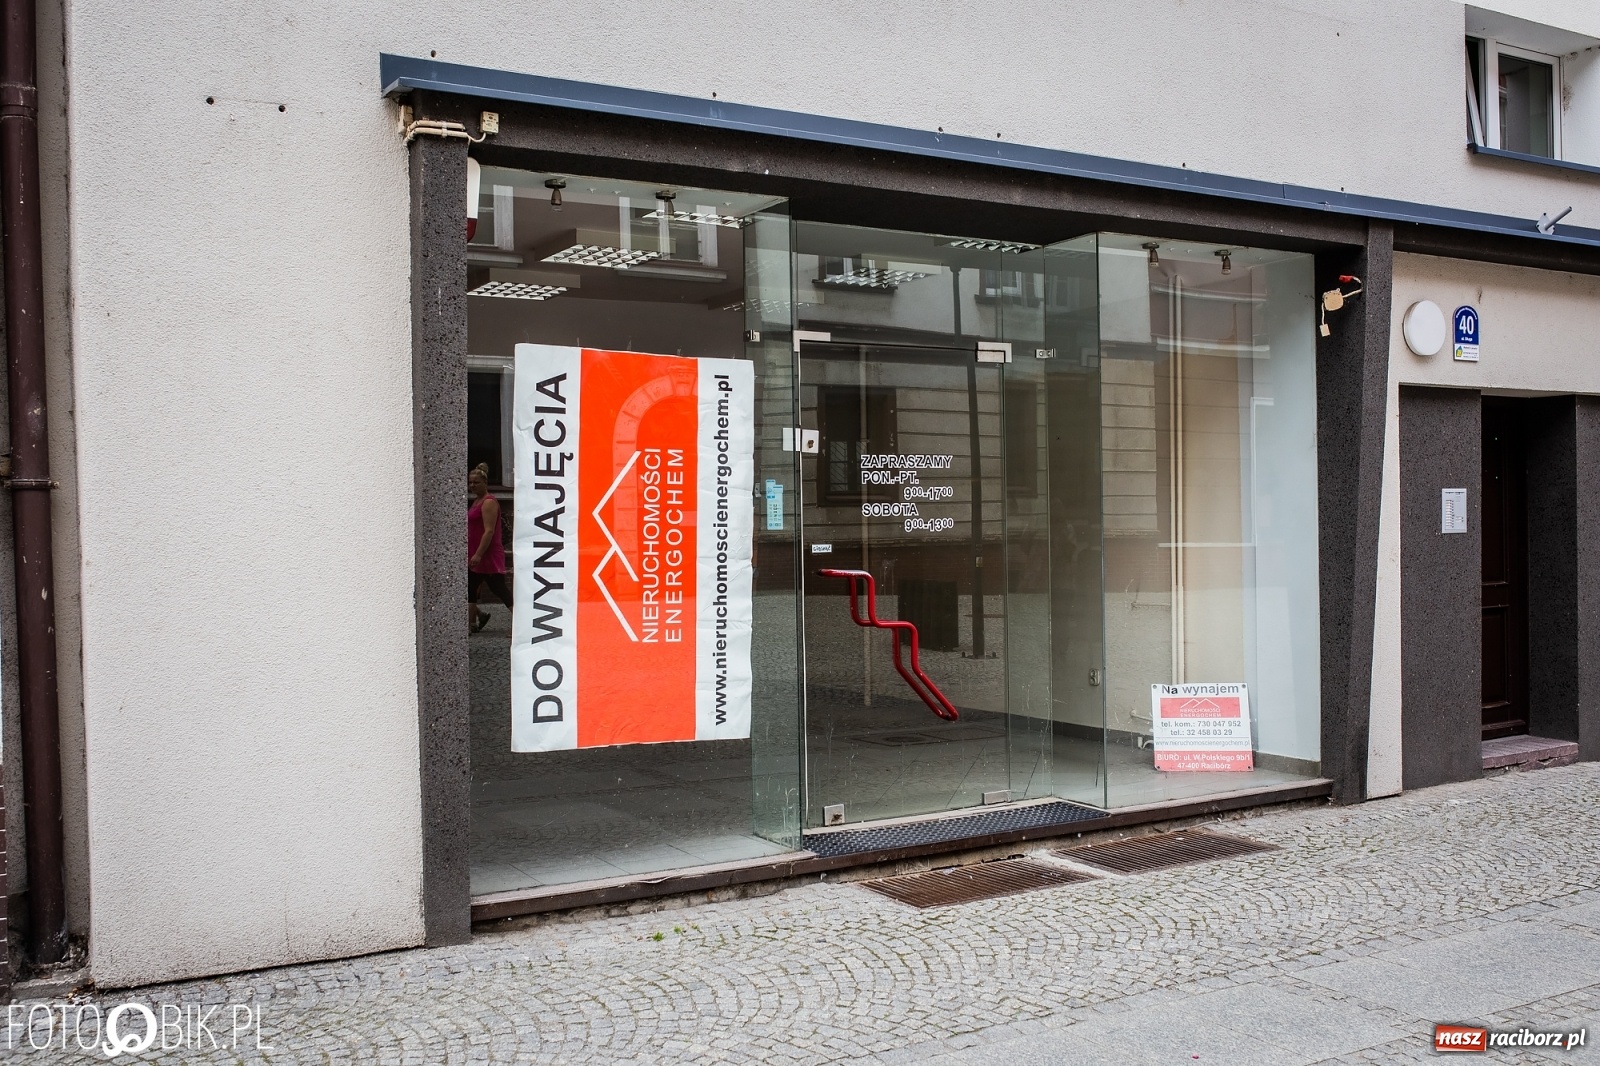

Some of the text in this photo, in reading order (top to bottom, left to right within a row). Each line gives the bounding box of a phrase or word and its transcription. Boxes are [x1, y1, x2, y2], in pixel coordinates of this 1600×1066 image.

[1459, 315, 1474, 335] 40
[860, 454, 953, 468] ZAPRASZAMY
[861, 470, 920, 484] PON.-PT.
[862, 502, 919, 516] SOBOTA
[531, 372, 574, 724] DO WYNAJĘCIA
[640, 447, 661, 643] NIERUCHOMOŚCI
[665, 448, 684, 643] ENERGOCHEM
[712, 374, 733, 726] www.nieruchomoscienergochem.pl
[1161, 683, 1239, 696] Na wynajem
[1197, 720, 1211, 728] 730
[1213, 720, 1226, 728] 047
[1227, 720, 1241, 728] 952
[1156, 753, 1182, 761] BIURO:
[1183, 753, 1192, 761] ul.
